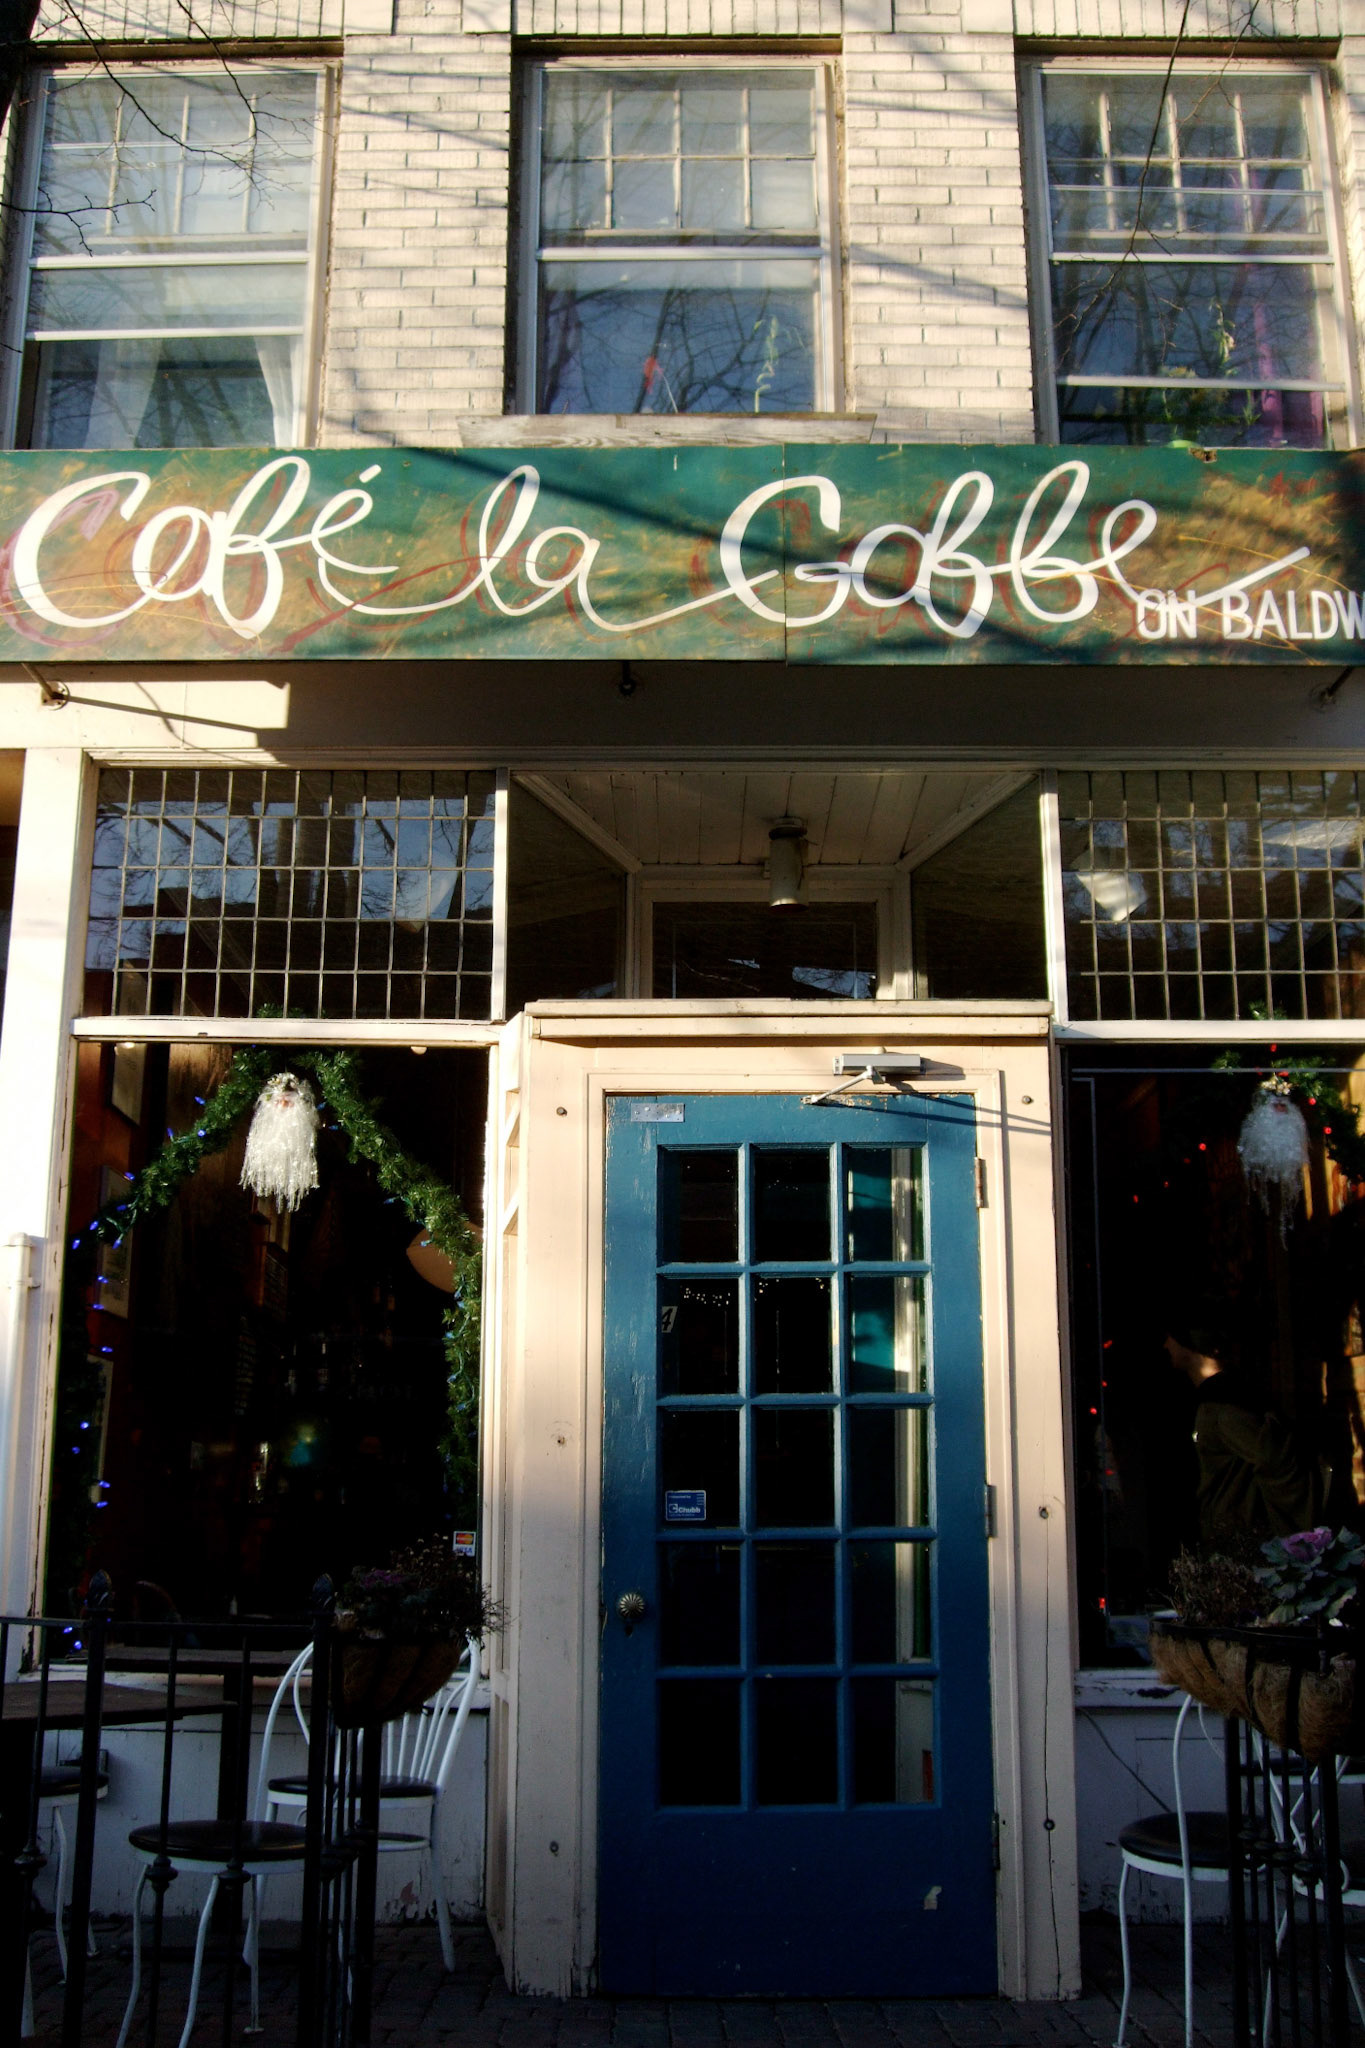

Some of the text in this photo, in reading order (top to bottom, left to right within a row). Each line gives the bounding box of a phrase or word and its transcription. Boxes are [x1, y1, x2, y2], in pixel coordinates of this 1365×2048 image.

[13, 456, 398, 639] Café
[420, 464, 665, 632] la
[1136, 589, 1365, 640] ON BALDW
